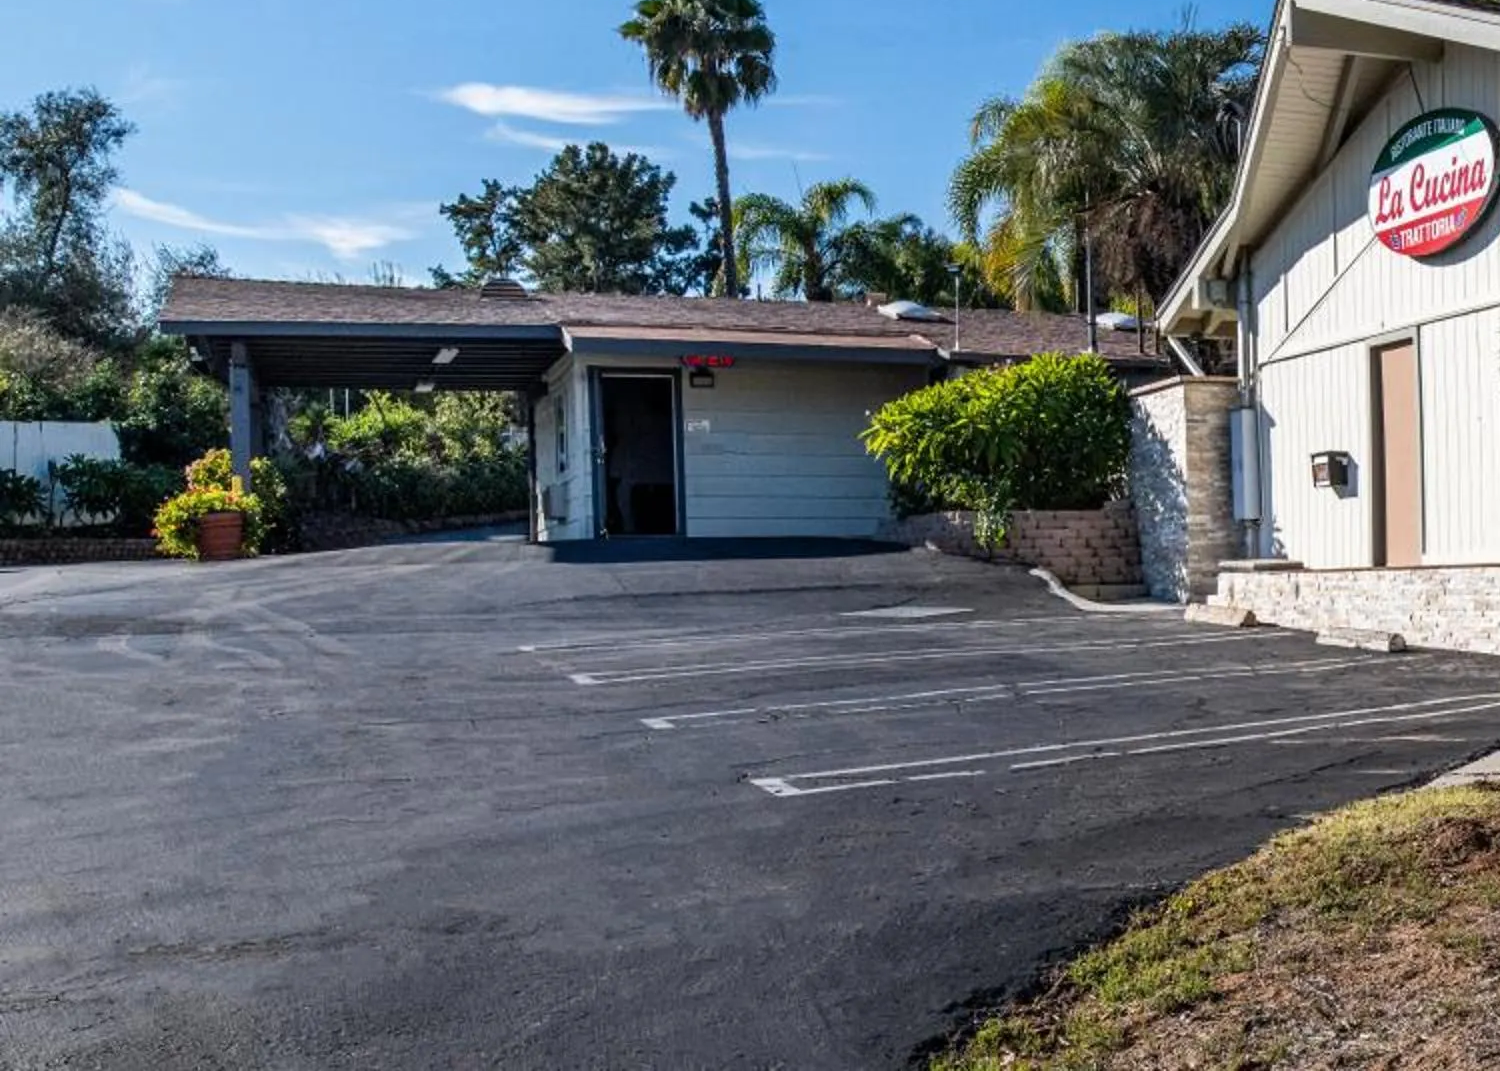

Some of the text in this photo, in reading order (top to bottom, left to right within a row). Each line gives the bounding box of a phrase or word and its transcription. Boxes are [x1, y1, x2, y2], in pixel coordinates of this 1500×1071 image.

[1375, 156, 1487, 225] La Cucina
[1399, 213, 1456, 250] TRATTORIA
